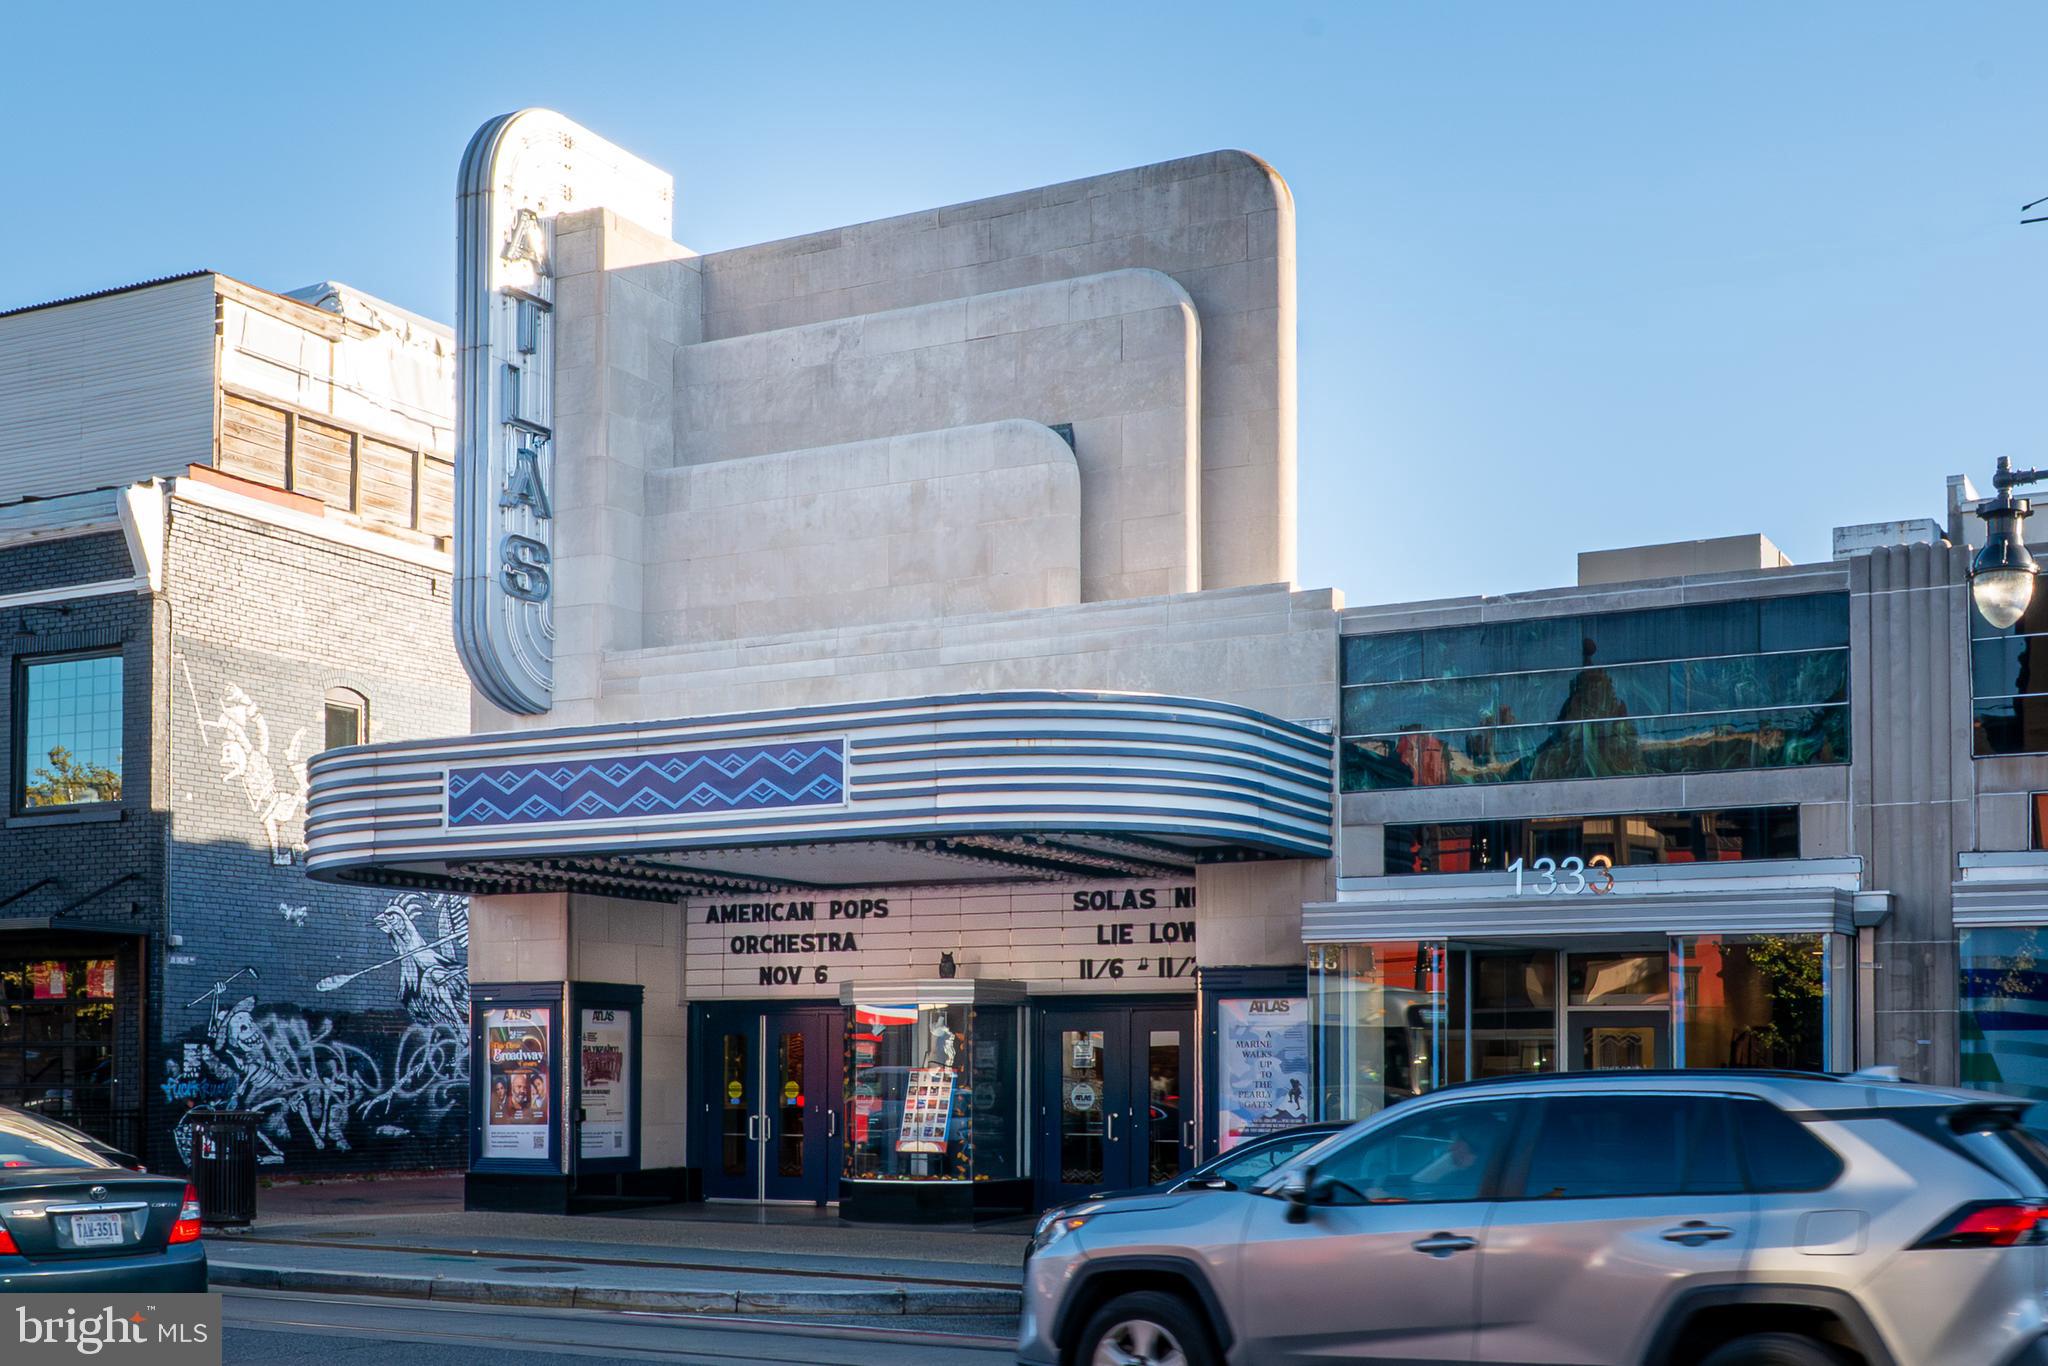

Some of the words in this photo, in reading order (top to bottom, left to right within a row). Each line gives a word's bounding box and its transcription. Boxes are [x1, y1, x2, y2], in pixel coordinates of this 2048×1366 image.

[499, 208, 553, 601] ATLAS
[1507, 854, 1614, 895] 1333
[1073, 888, 1157, 911] SOLAS
[706, 902, 814, 924] AMERICAN
[829, 898, 889, 919] POPS
[730, 932, 857, 954] ORCHESTRA
[1097, 923, 1133, 945] LIE
[1149, 921, 1196, 943] LOW
[759, 966, 803, 985] NOV
[814, 965, 828, 984] 6
[1079, 958, 1124, 979] 11/6
[592, 1011, 615, 1022] ATLAS
[1249, 1000, 1290, 1013] ATLAS
[1265, 1030, 1272, 1038] A
[493, 1049, 544, 1063] Broadway
[1242, 1050, 1272, 1058] WALKS
